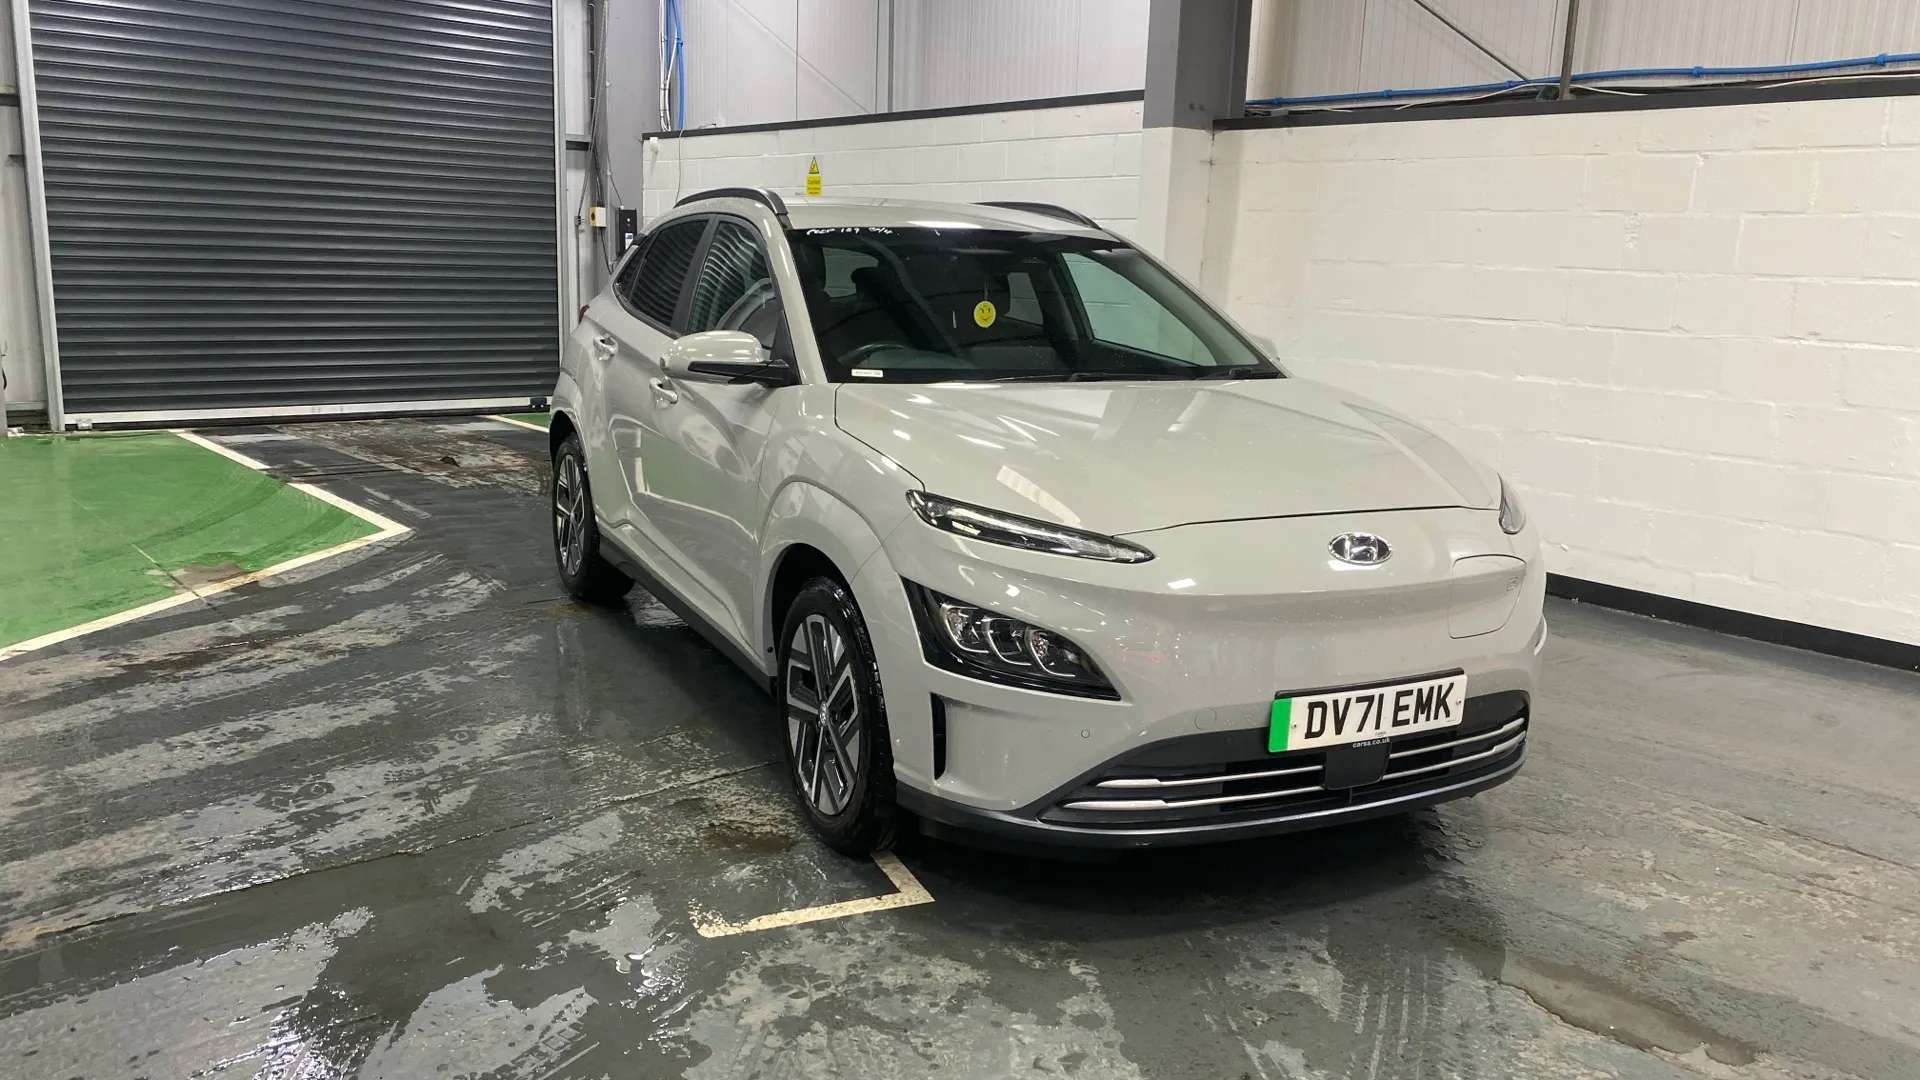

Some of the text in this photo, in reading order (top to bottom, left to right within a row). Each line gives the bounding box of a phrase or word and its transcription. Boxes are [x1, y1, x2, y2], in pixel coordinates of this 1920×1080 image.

[1304, 683, 1455, 740] DV71 EMK
[1352, 737, 1391, 749] carsa.co.uk
